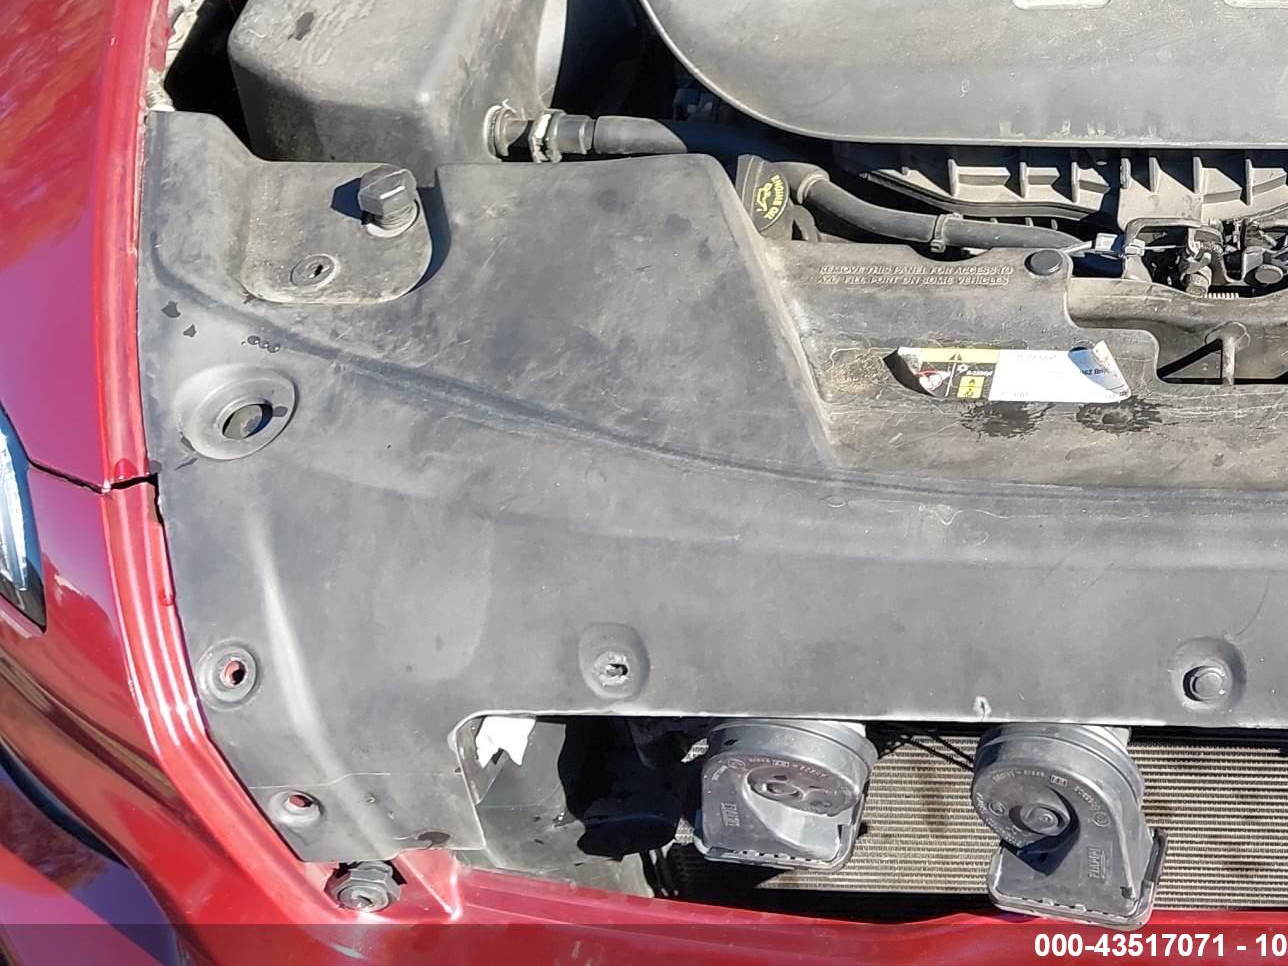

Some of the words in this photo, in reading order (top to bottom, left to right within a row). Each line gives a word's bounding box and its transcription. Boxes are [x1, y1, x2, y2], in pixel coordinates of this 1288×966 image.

[771, 174, 784, 205] ENGINE
[764, 206, 779, 219] OIL
[819, 265, 866, 275] REMOVE
[867, 265, 891, 275] THIS
[893, 265, 928, 275] PANEL
[930, 265, 954, 275] FOR
[955, 265, 997, 275] ACCESS
[870, 275, 899, 284] PORT
[902, 275, 920, 284] ON
[923, 275, 954, 284] SOME
[957, 275, 1010, 284] VEHICLES
